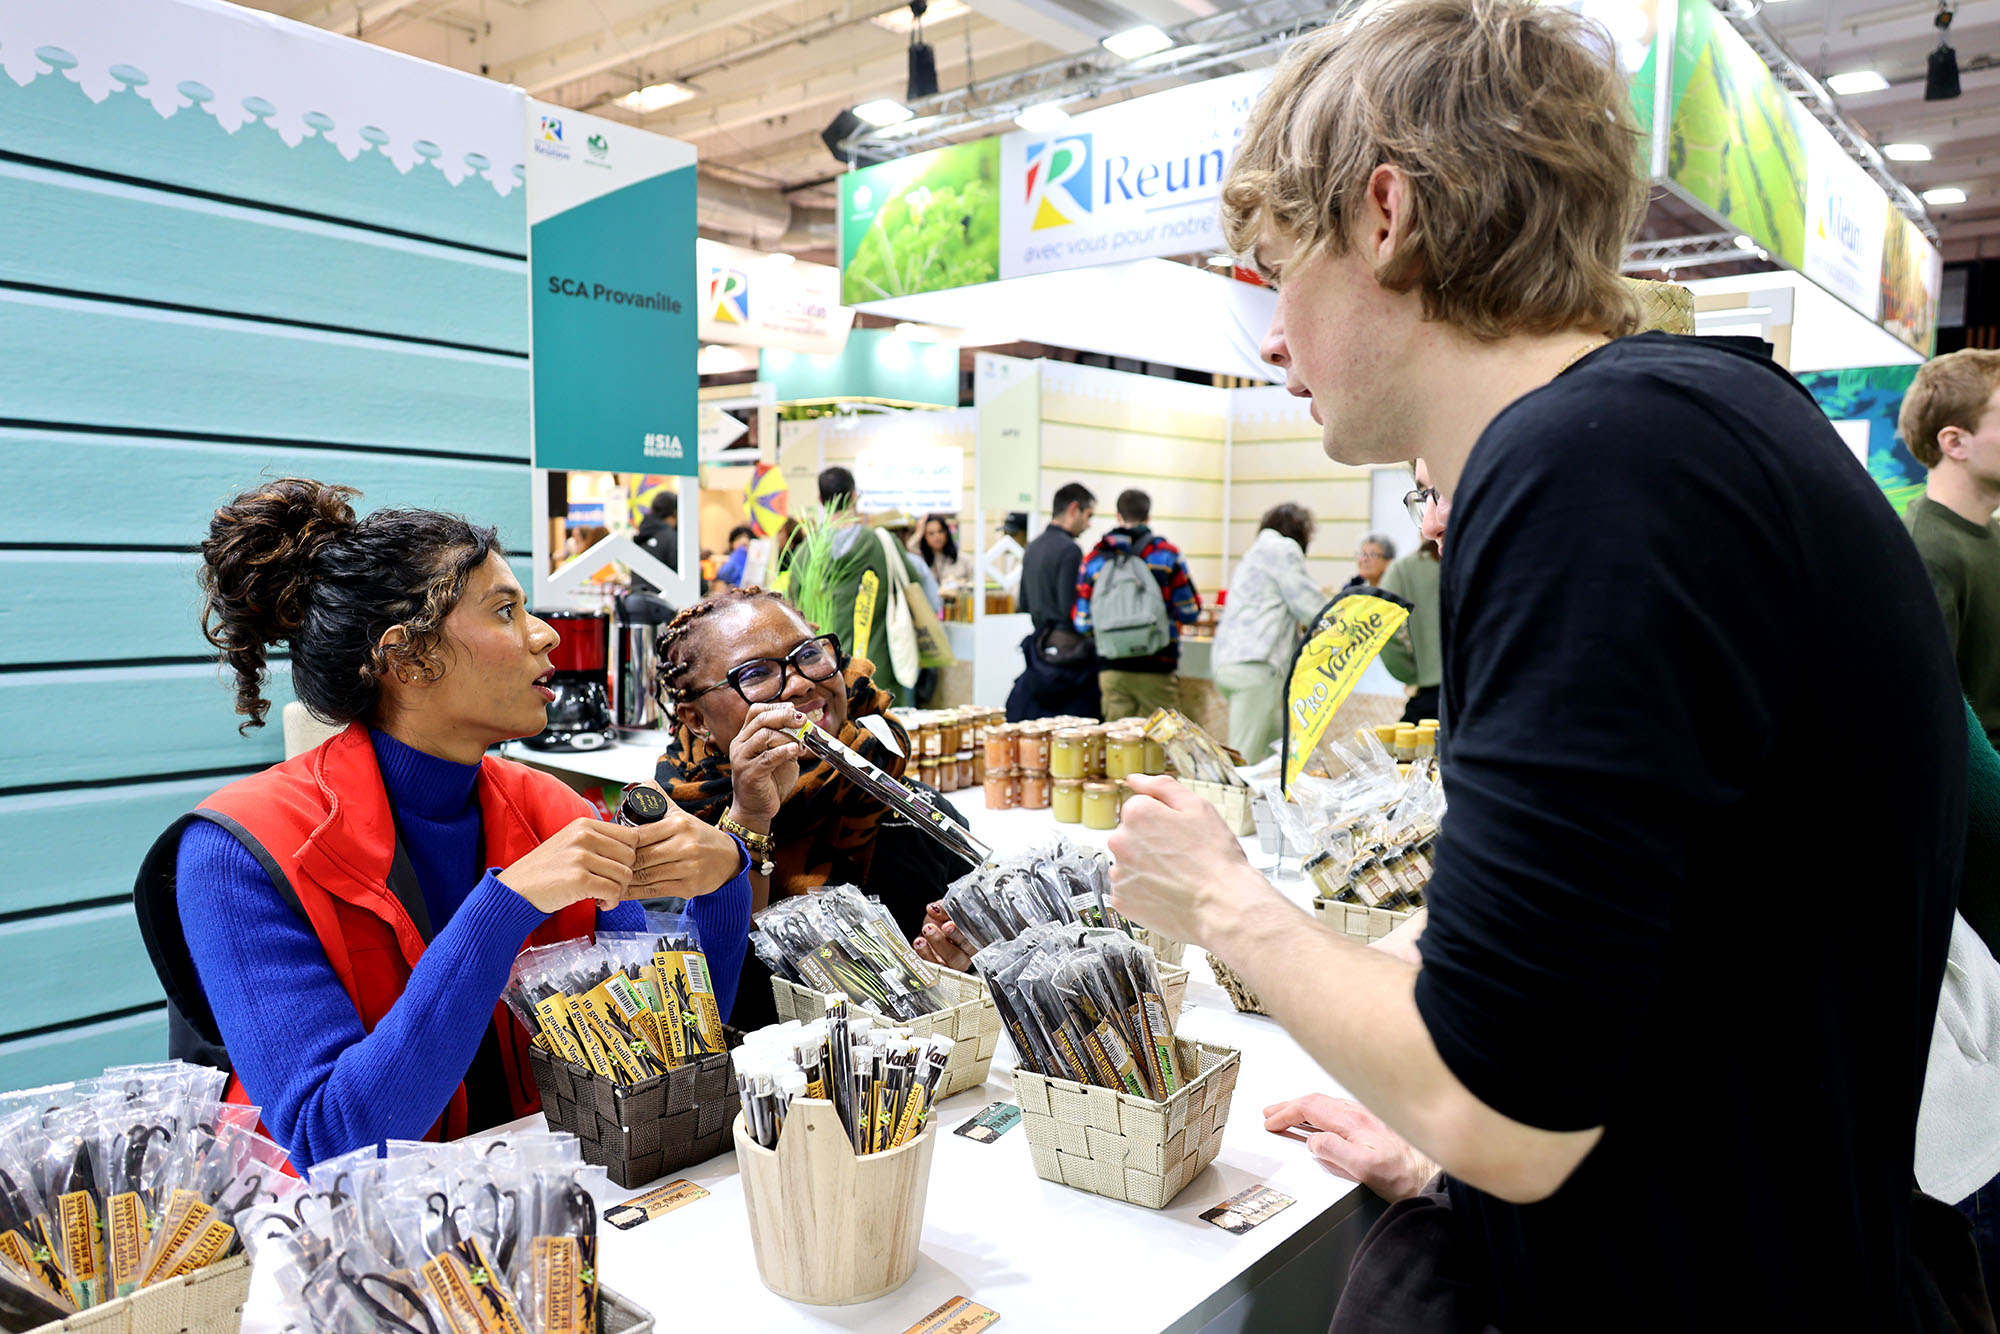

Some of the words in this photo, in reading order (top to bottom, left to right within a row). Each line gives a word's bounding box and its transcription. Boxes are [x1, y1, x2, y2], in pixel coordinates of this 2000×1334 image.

[1104, 148, 1225, 205] Reun
[1024, 242, 1064, 263] avec
[1066, 235, 1108, 255] vous
[1112, 227, 1156, 251] pour
[1161, 216, 1214, 240] notre
[548, 276, 589, 298] SCA
[593, 285, 682, 314] Provanille
[644, 433, 682, 449] #SIA
[657, 956, 666, 965] 10
[802, 962, 822, 987] Gousses
[657, 967, 672, 999] gousses
[816, 967, 836, 990] Vanille
[541, 1004, 553, 1015] 10
[569, 1000, 580, 1010] 10
[582, 999, 593, 1009] 10
[667, 1000, 678, 1030] Vanille
[545, 1015, 569, 1046] gousses
[572, 1011, 593, 1043] gousses
[587, 1010, 614, 1039] gousses
[612, 1037, 632, 1065] Vanille
[673, 1029, 682, 1052] extra
[926, 1043, 948, 1067] Van
[1059, 1031, 1072, 1056] Extra
[1089, 1036, 1104, 1062] Extra
[591, 1043, 607, 1072] Vanille
[1071, 1055, 1088, 1084] Vanille
[630, 1064, 644, 1081] extr
[1102, 1060, 1118, 1091] Vanille
[65, 1197, 81, 1276] COOPERATIVE
[76, 1195, 89, 1258] BRAS-PANON
[114, 1198, 129, 1278] COOPERATIVE
[124, 1196, 137, 1260] BRAS-PANON
[175, 1225, 220, 1275] PERATIVE
[83, 1262, 91, 1274] DE
[561, 1242, 569, 1311] BRAS-PANON
[552, 1244, 560, 1330] COOPERATIVE
[561, 1317, 568, 1329] DE
